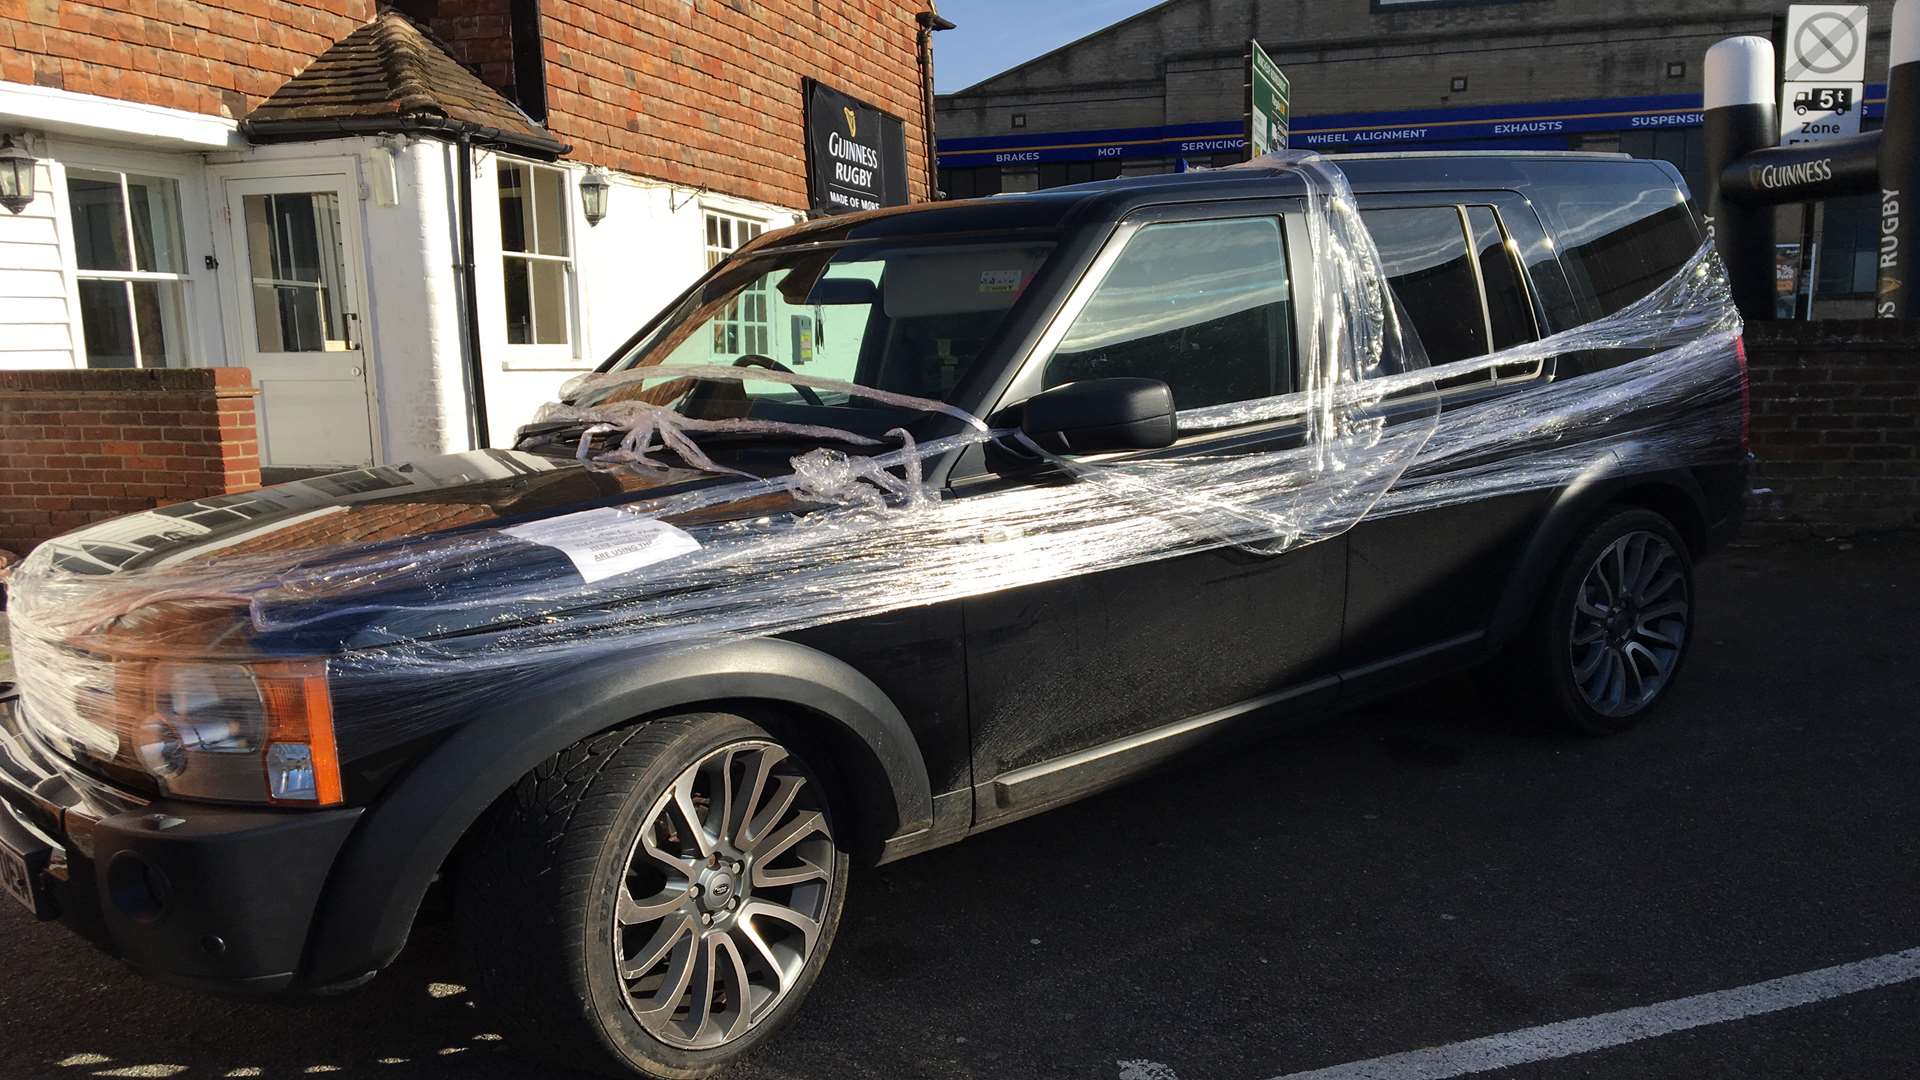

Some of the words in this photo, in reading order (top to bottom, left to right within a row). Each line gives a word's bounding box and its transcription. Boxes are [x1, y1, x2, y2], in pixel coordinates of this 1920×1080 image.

[1495, 121, 1562, 133] EXHAUSTS
[1801, 122, 1840, 134] Zone
[1307, 134, 1349, 144] WHEEL
[1354, 129, 1427, 142] ALIGNMENT
[829, 131, 878, 168] GUINNESS
[1098, 147, 1123, 157] MOT
[1181, 139, 1245, 151] SERVICING
[996, 152, 1040, 162] BRAKES
[836, 162, 872, 188] RUGBY
[1762, 158, 1832, 189] GUINNESS
[829, 191, 849, 206] MADE
[850, 197, 860, 208] OF
[1880, 189, 1900, 269] RUGBY
[611, 543, 639, 557] USING
